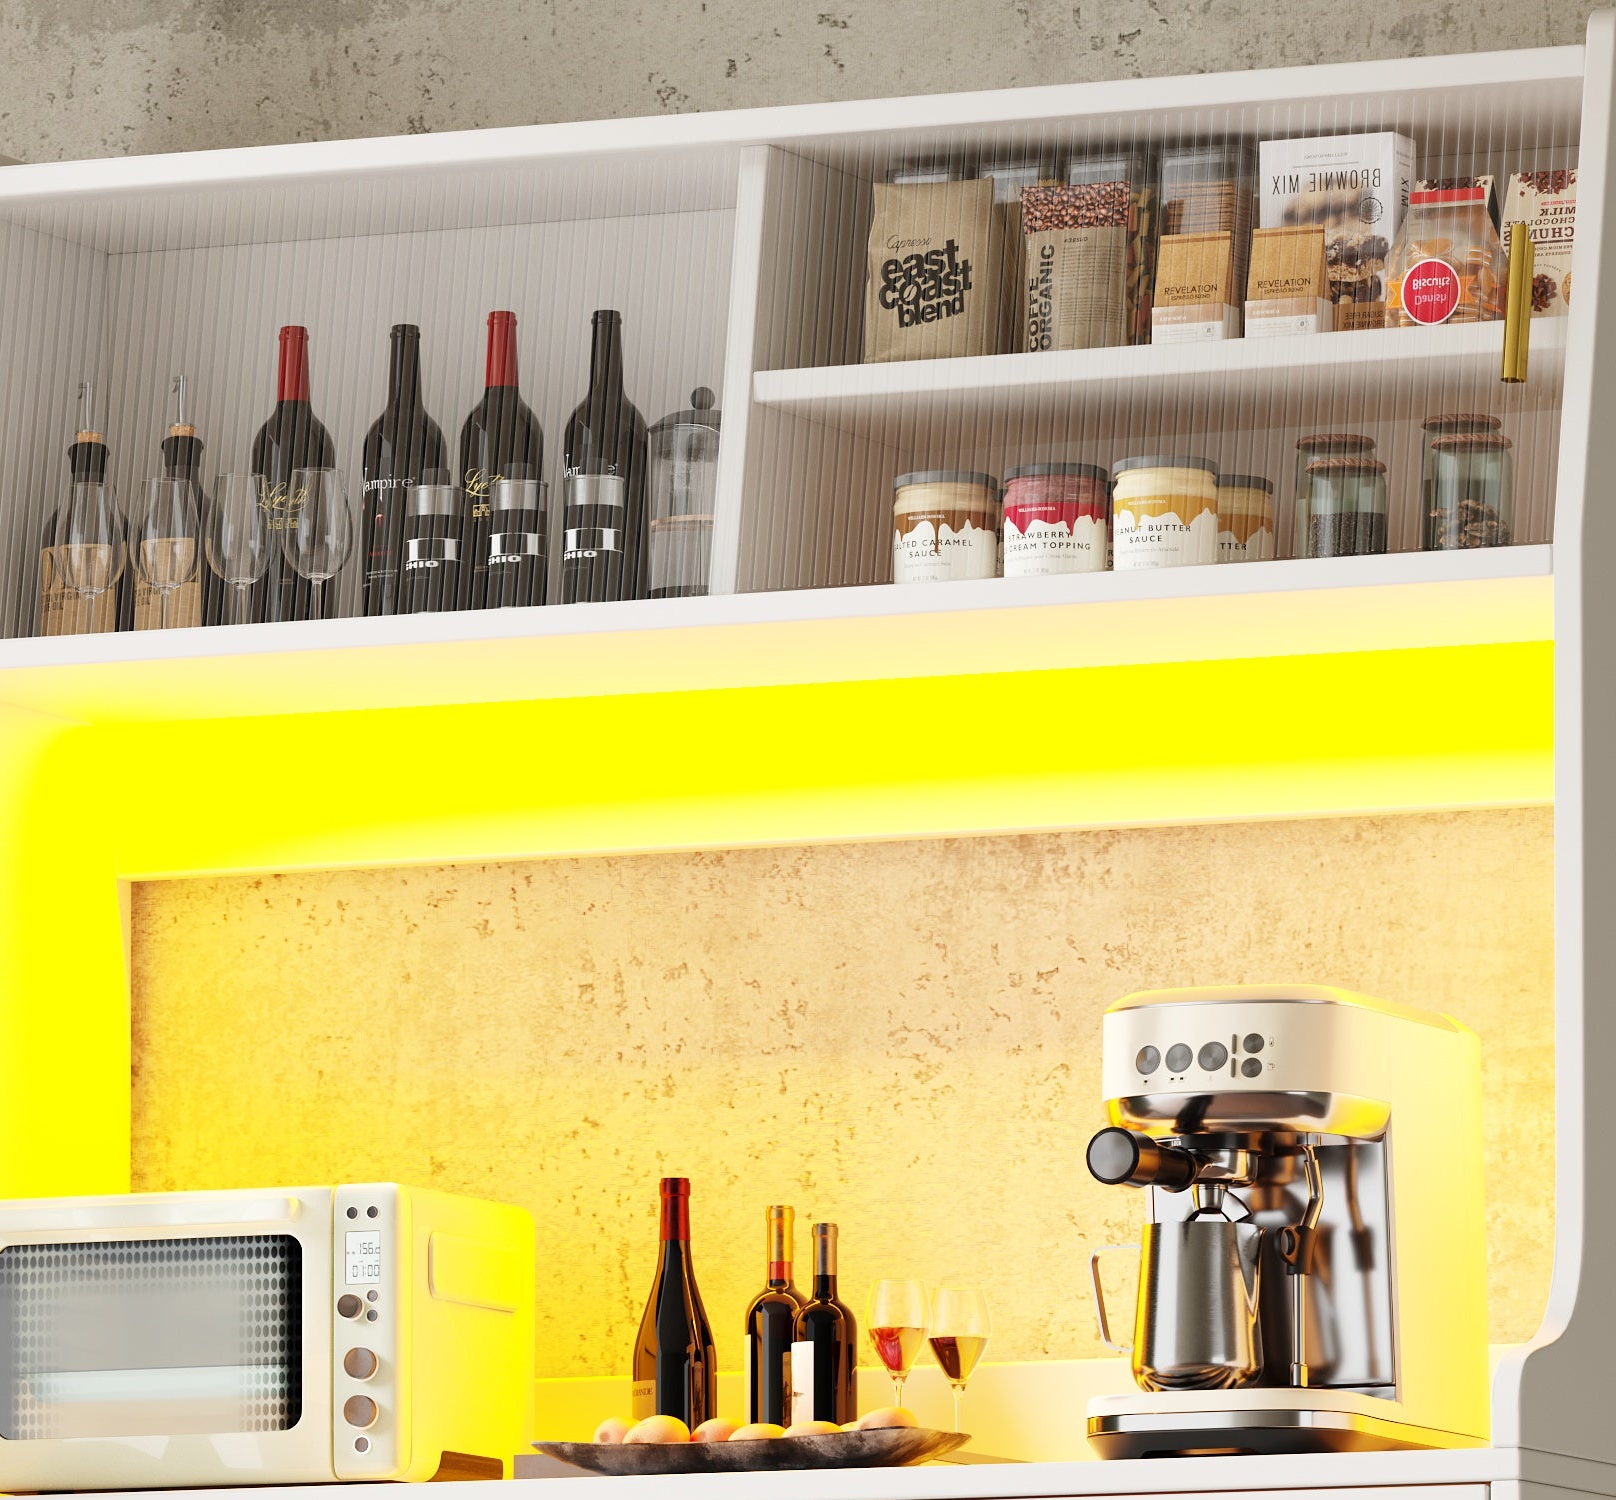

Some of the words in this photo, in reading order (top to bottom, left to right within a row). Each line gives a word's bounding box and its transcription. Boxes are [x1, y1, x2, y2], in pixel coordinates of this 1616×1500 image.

[881, 239, 959, 283] east
[879, 259, 972, 310] coast
[1258, 277, 1311, 289] REVELATION
[1164, 283, 1217, 296] REVELATION
[1039, 244, 1054, 351] ORGANIC
[898, 289, 964, 328] blend
[1148, 524, 1191, 532] BUTTER
[1129, 535, 1163, 544] SAUCE
[1043, 541, 1091, 551] TOPPING
[909, 549, 942, 558] SAUCE
